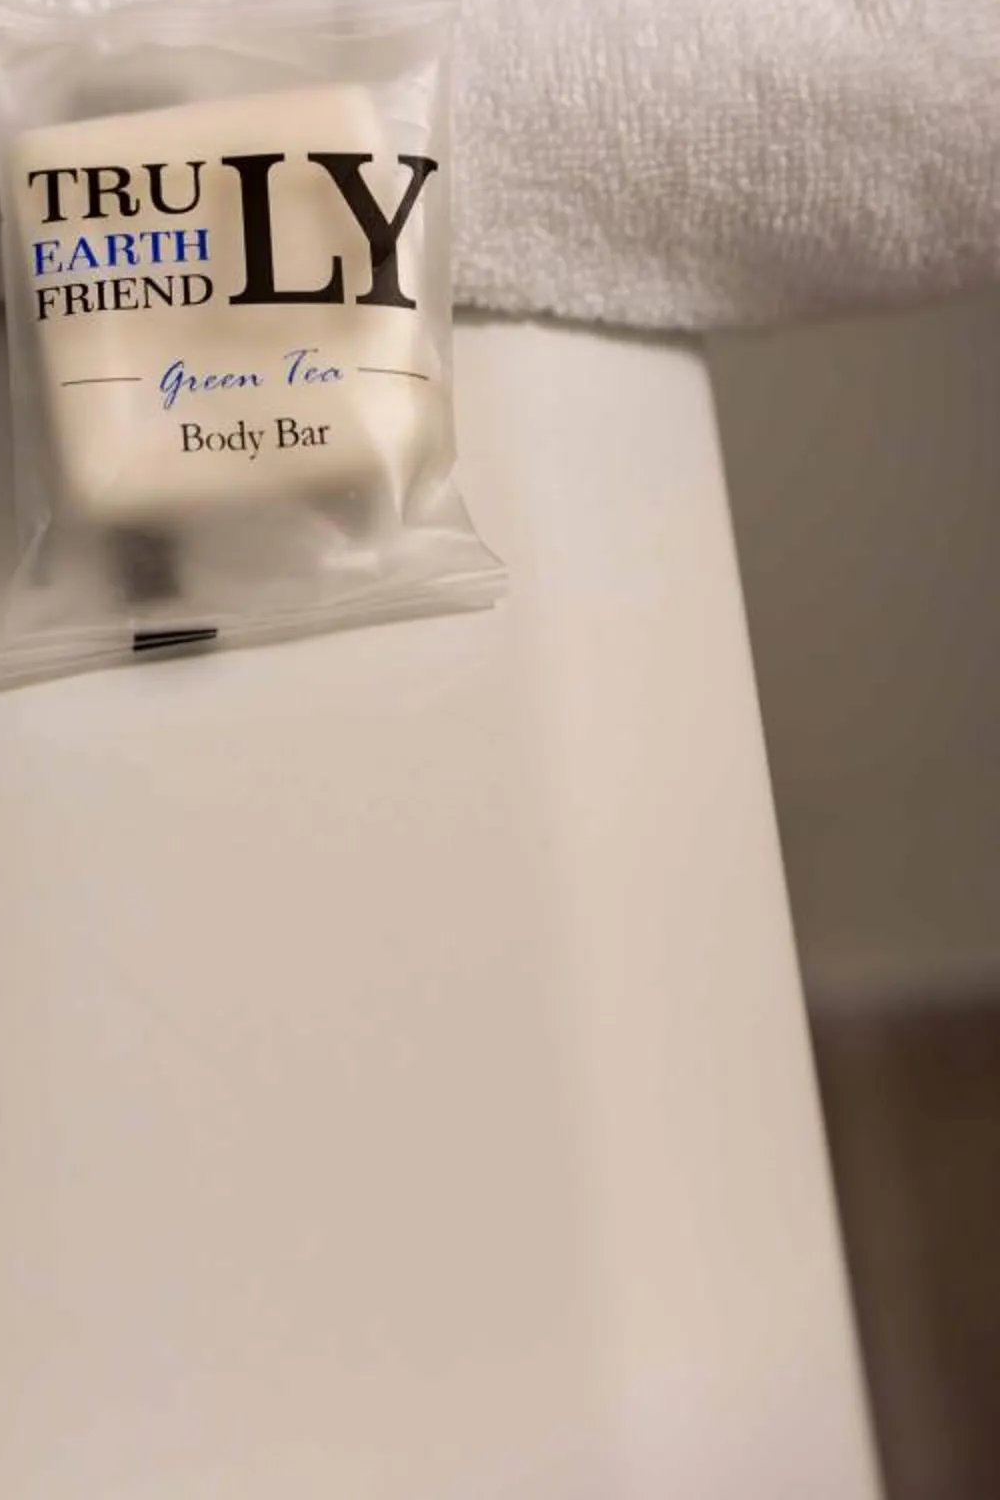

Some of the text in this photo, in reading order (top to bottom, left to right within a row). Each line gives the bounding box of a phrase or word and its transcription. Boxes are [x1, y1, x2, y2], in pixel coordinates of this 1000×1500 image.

[28, 160, 206, 224] TRU
[31, 228, 210, 278] EARTH
[221, 152, 439, 310] LY
[35, 273, 214, 322] FRIEND
[159, 347, 344, 411] Green Tea
[180, 416, 331, 461] Body Bar
